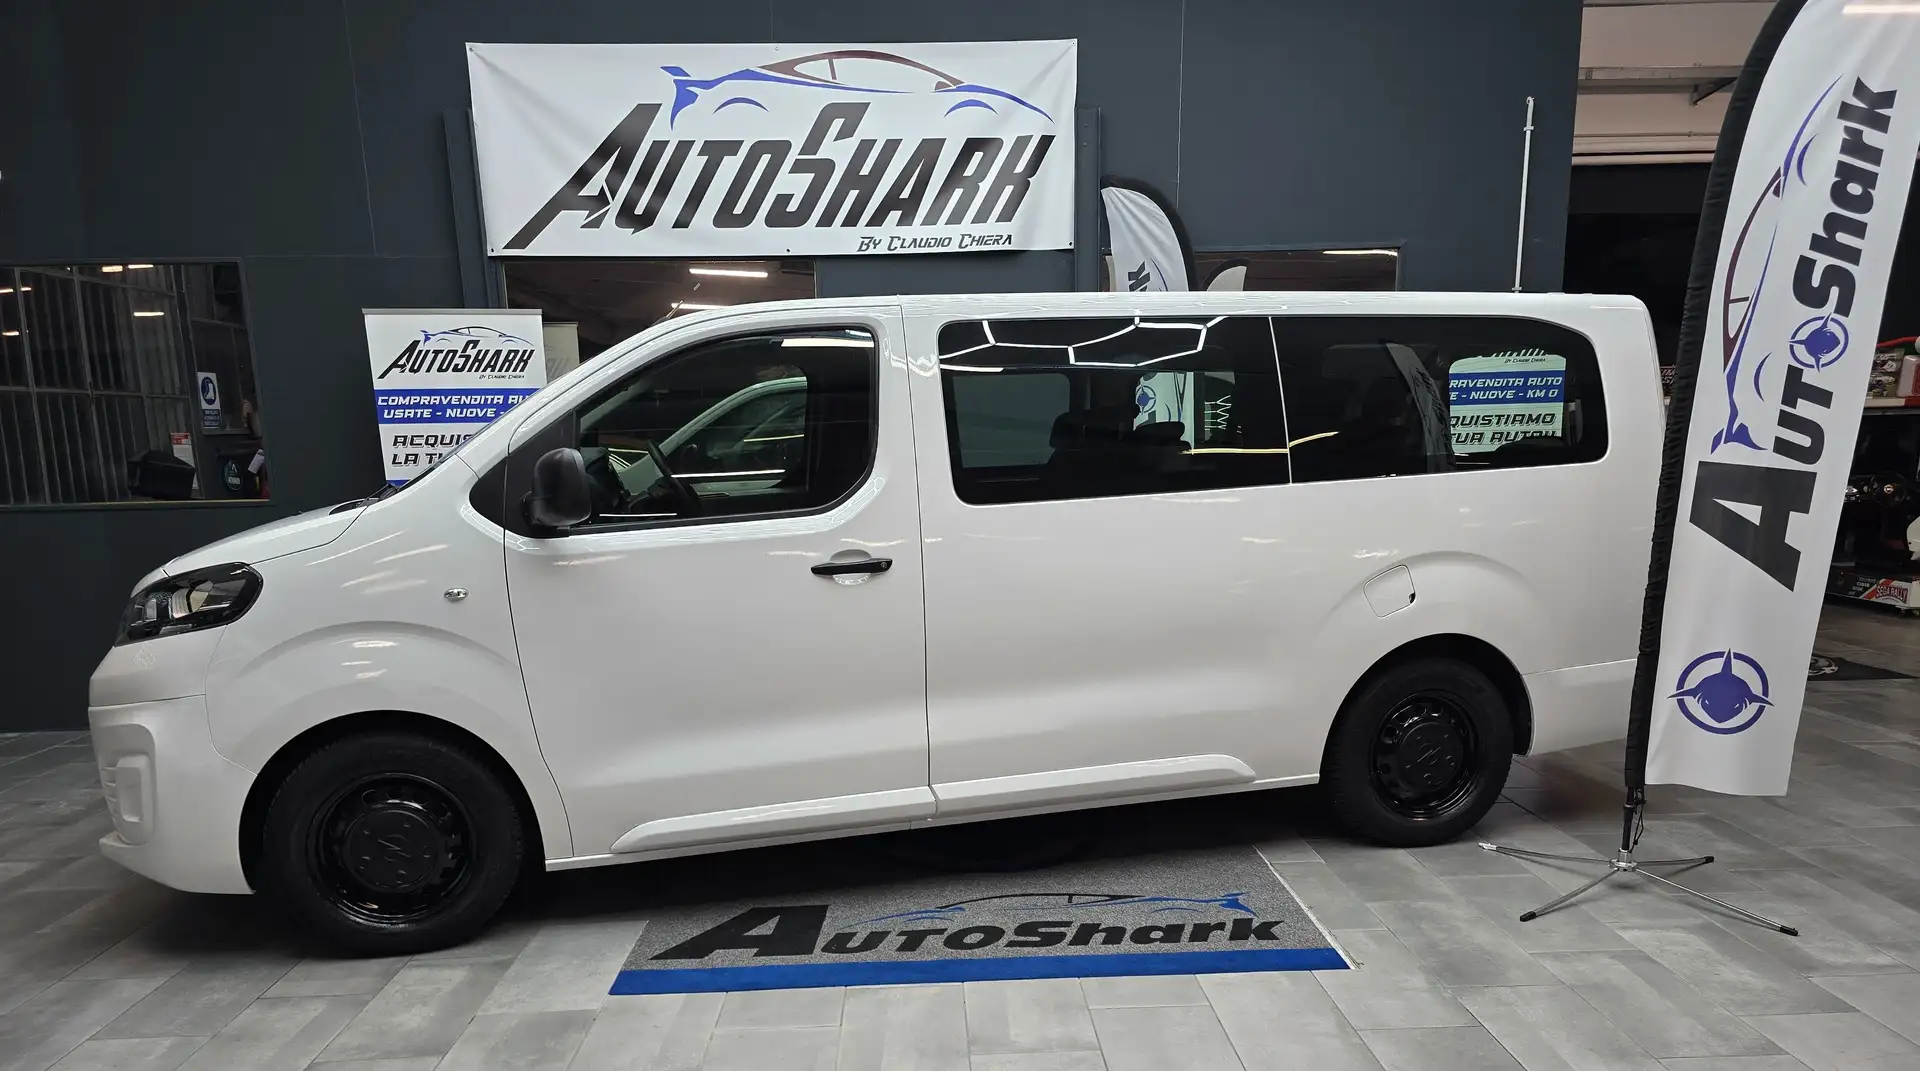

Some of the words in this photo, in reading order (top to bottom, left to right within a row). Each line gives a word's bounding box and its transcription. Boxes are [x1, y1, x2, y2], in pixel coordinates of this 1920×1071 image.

[857, 236, 882, 252] BY
[887, 235, 952, 251] CLAUDIO
[958, 233, 1012, 249] CHIERA
[1449, 378, 1524, 388] RAVENDITA
[1527, 377, 1563, 386] AUTO
[1470, 390, 1515, 400] NUOVE
[1527, 389, 1545, 398] KM
[377, 395, 504, 406] COMPRAVENDITA
[383, 409, 432, 418] USATE
[446, 408, 496, 418] NUOVE
[392, 453, 419, 467] LA
